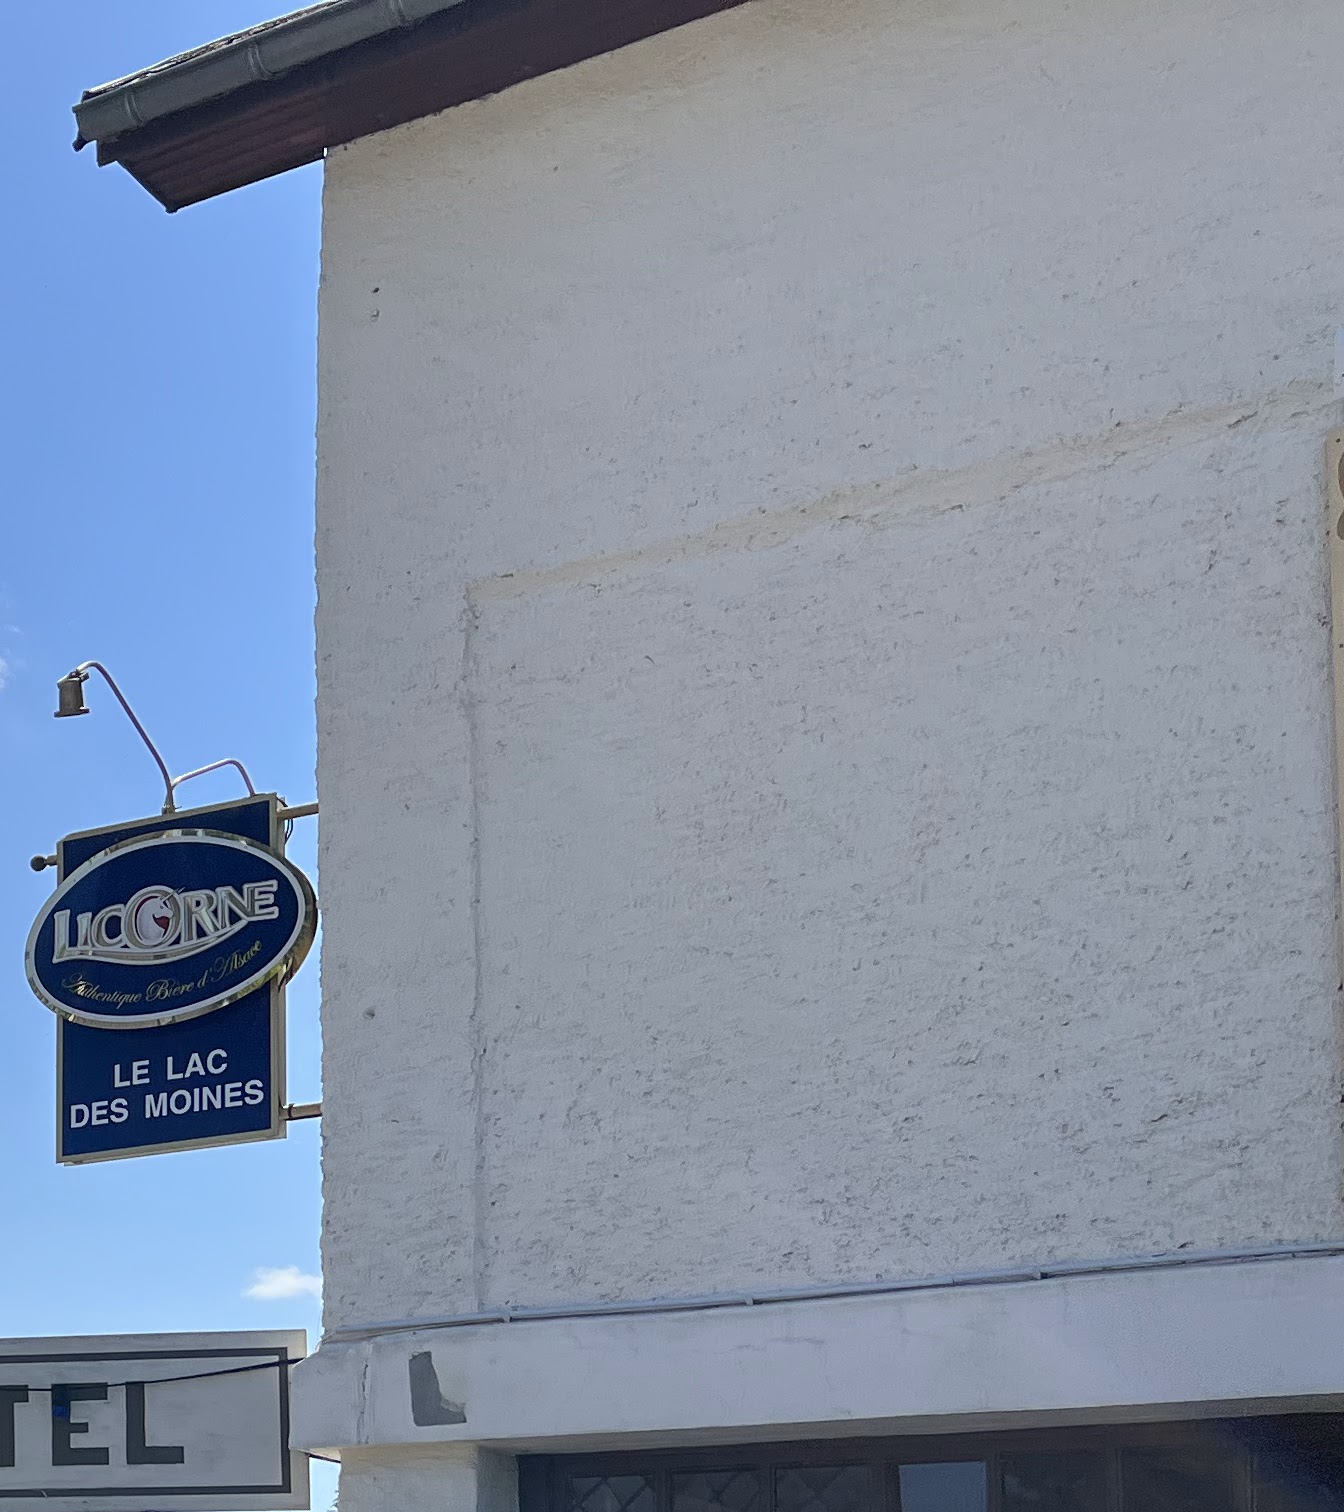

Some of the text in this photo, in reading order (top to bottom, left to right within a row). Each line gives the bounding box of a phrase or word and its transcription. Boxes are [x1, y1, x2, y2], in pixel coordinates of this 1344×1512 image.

[53, 880, 278, 963] LICORNE
[63, 973, 141, 1009] Authentique
[146, 979, 194, 1000] Bière
[113, 1049, 228, 1088] LE LAC
[70, 1080, 264, 1129] DES MOINES
